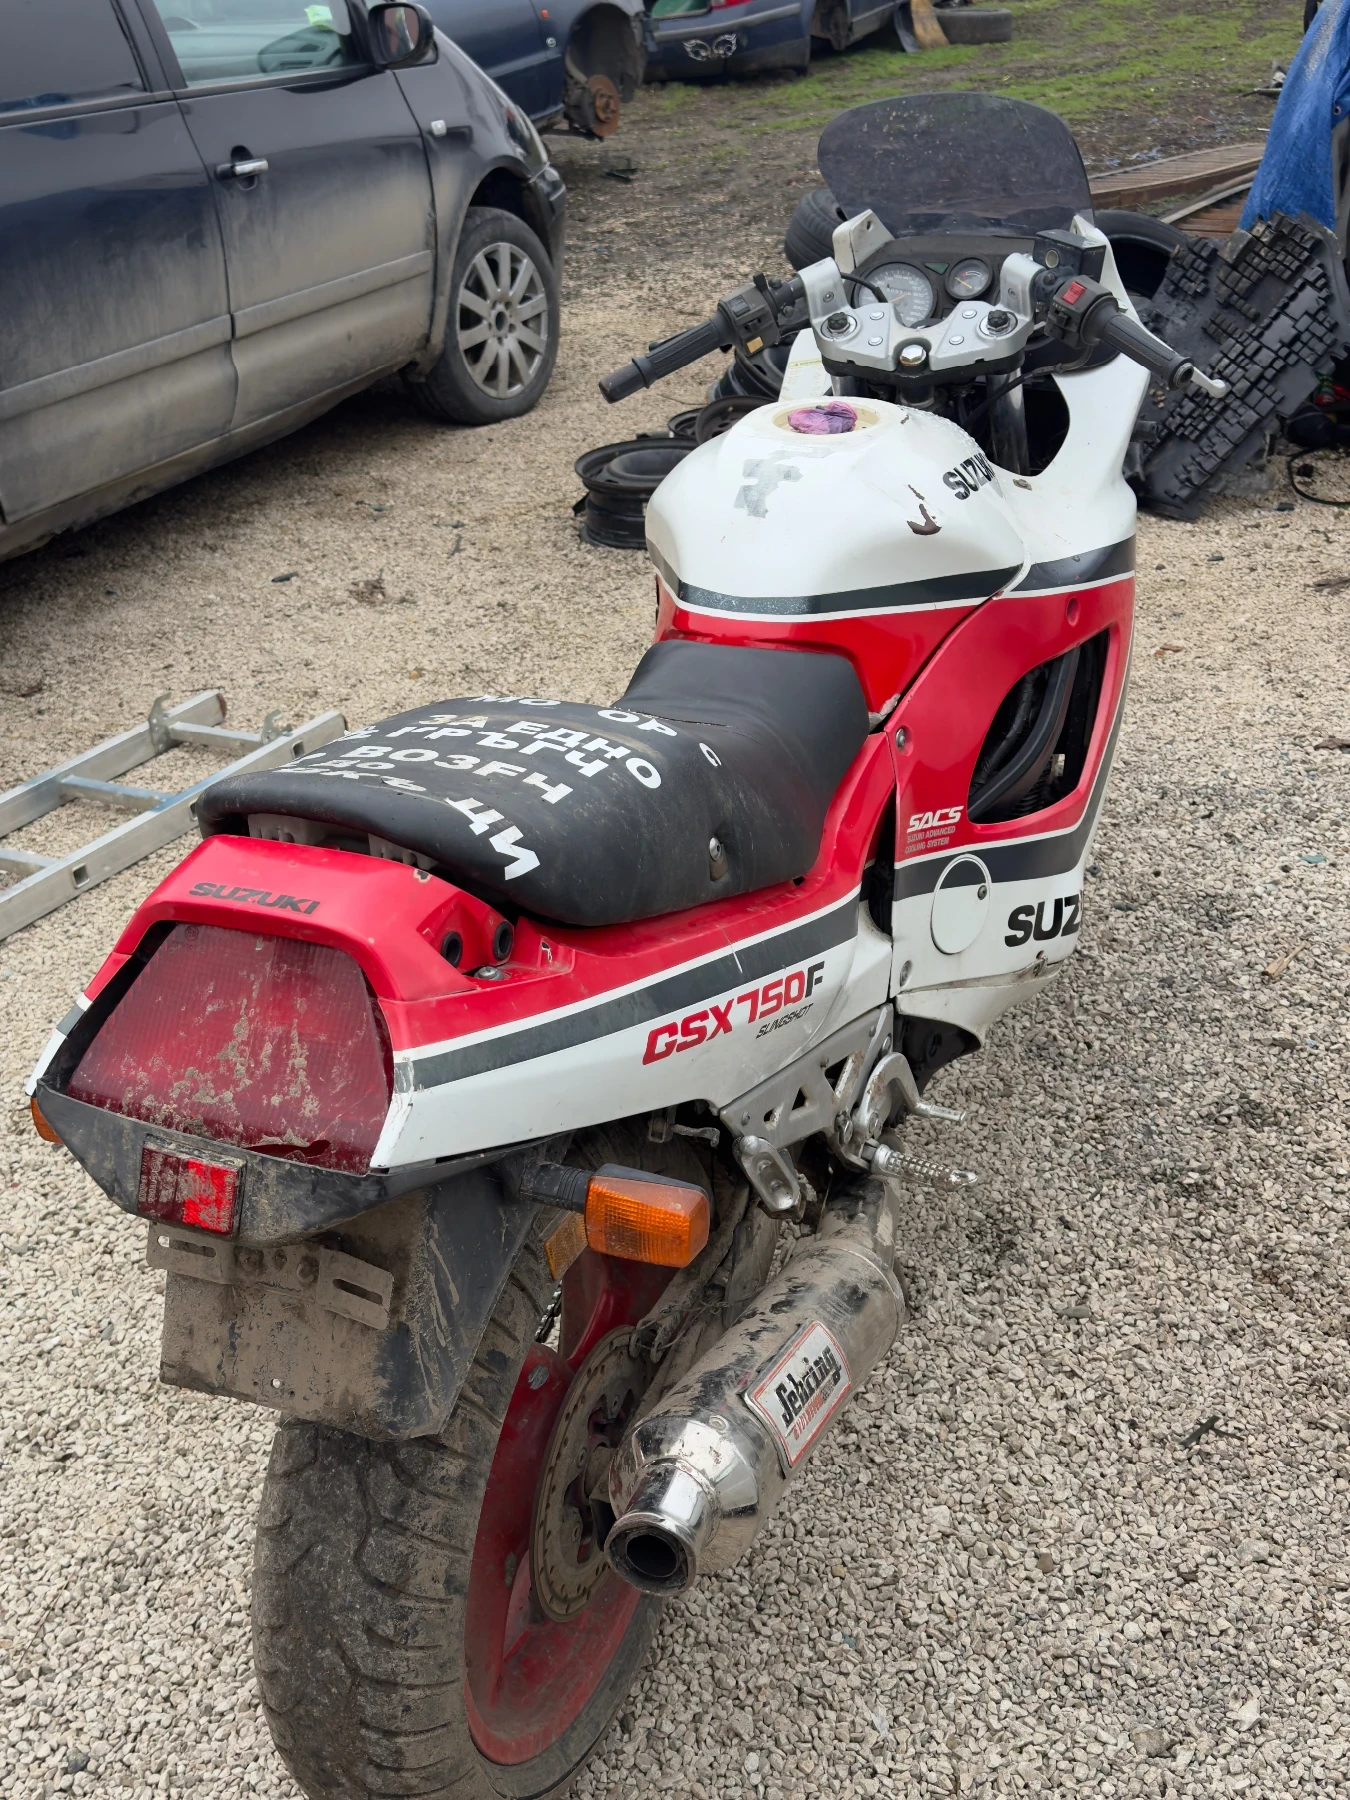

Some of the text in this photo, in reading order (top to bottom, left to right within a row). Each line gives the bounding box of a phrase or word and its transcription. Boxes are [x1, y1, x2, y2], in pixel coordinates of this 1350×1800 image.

[418, 714, 662, 789] ЗА ЕДНО
[907, 806, 964, 833] SACS
[907, 825, 956, 844] SUZUKI ADVANCED
[905, 836, 950, 854] COOLING SYSTEM
[189, 882, 320, 915] SUZUKI
[755, 1002, 814, 1039] SLINGSHOT
[775, 1345, 842, 1429] Sebring
